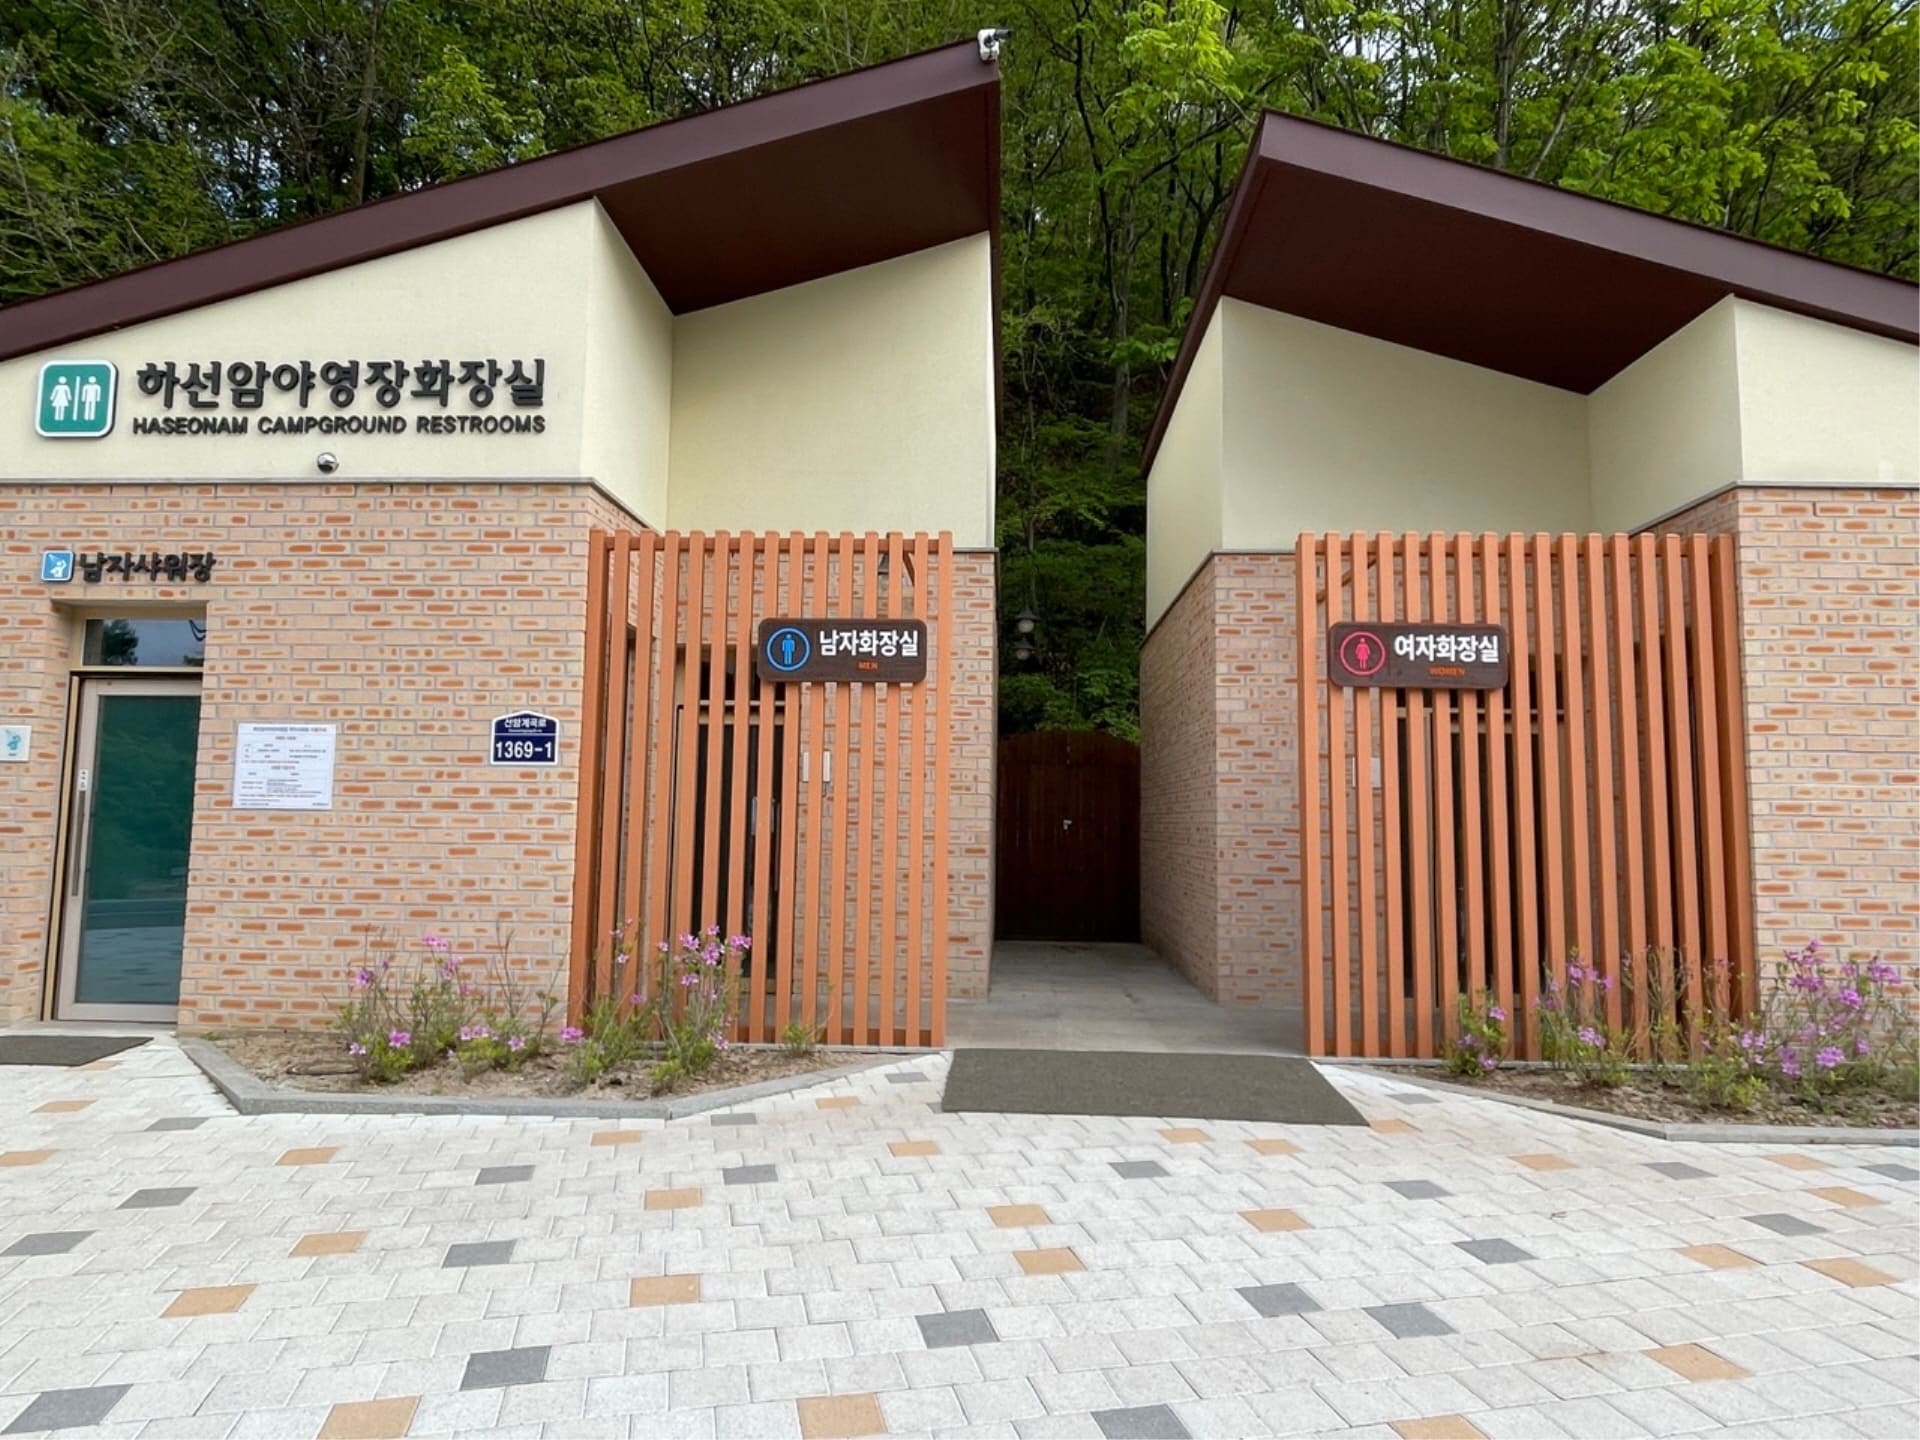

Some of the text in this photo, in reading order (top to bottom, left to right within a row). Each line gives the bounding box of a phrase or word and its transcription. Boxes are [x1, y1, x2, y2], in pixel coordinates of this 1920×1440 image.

[136, 359, 545, 408] 하선암야영장화장실
[133, 415, 546, 435] HASEONAM CAMPGROUND RESTROOMS
[79, 551, 216, 583] 남자샤워장
[819, 629, 919, 657] 남자화장실
[1394, 633, 1499, 663] 여자화장실
[857, 661, 880, 670] MEN
[495, 740, 552, 759] 1369-1
